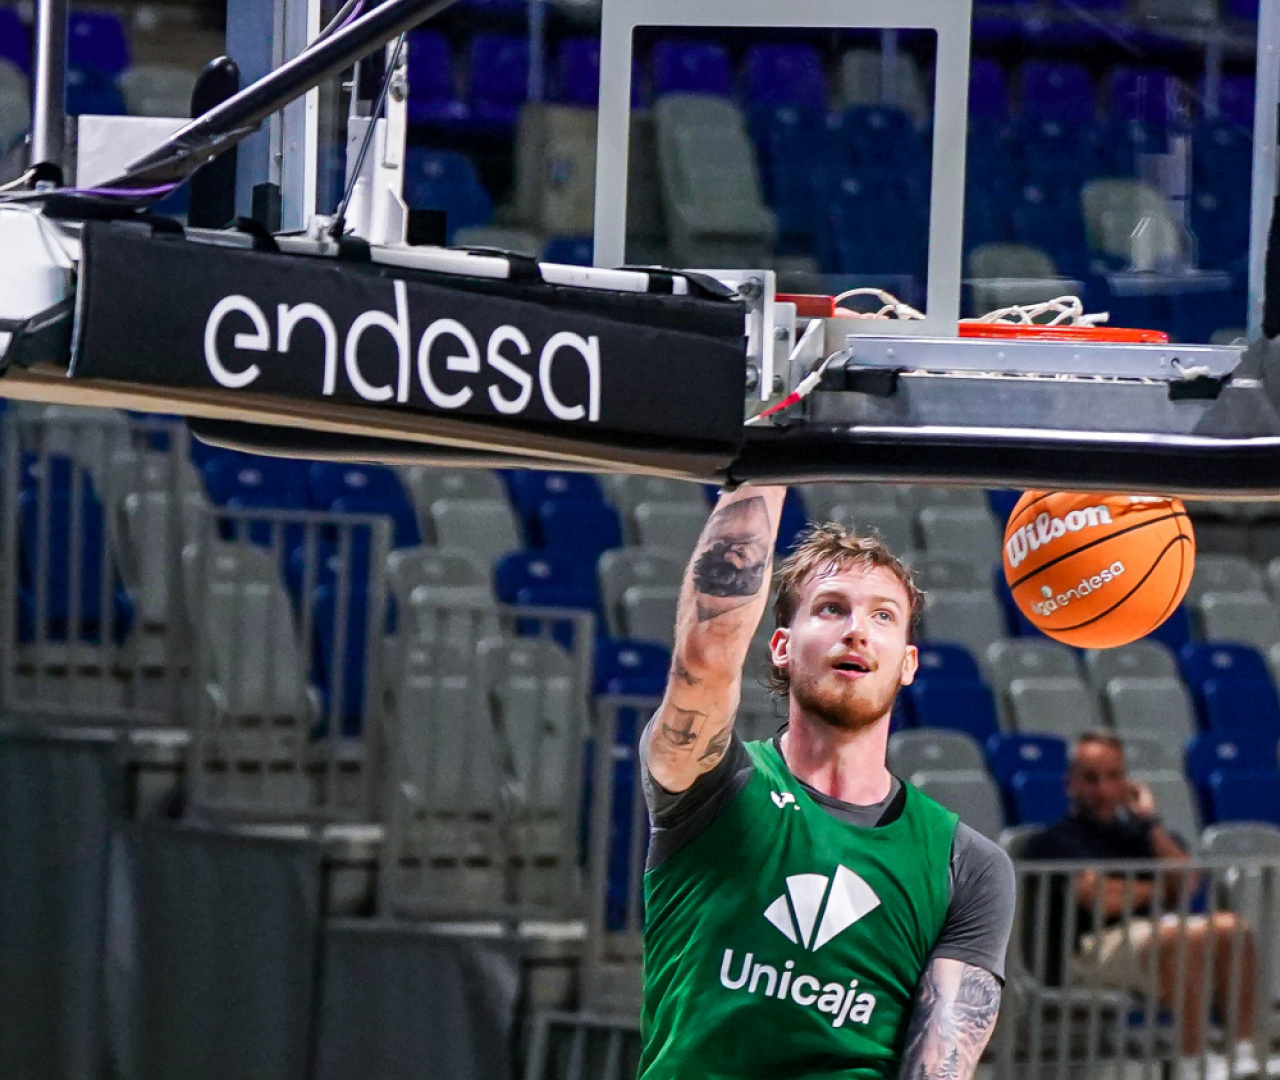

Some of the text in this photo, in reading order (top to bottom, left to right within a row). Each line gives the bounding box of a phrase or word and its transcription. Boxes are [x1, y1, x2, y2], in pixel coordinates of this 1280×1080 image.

[204, 279, 601, 422] endesa
[1005, 505, 1113, 568] Wilson
[1056, 560, 1125, 607] endesa
[720, 948, 877, 1028] Unicaja
